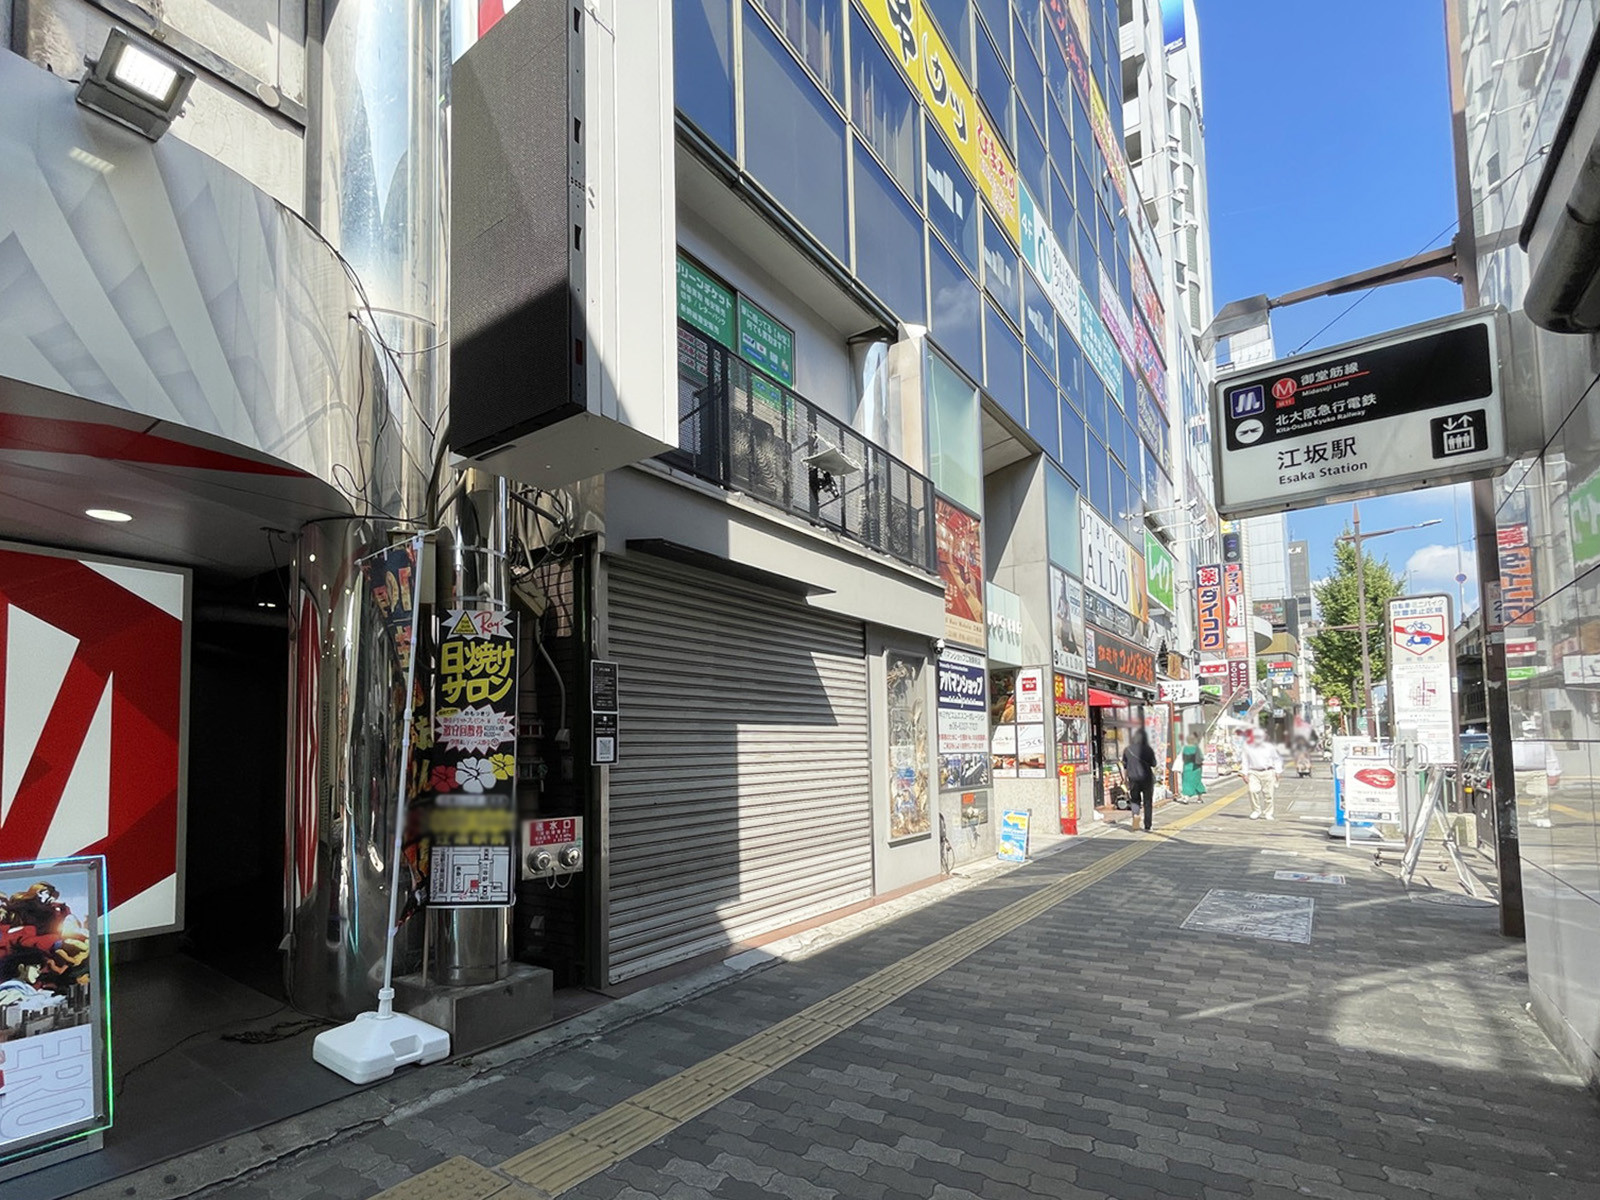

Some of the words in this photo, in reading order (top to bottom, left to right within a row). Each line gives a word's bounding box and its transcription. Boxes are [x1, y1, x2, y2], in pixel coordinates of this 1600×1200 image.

[1301, 362, 1359, 386] 御堂筋線
[1333, 380, 1350, 390] Line
[1275, 393, 1377, 426] 北大阪急行電鉄
[1276, 421, 1313, 435] Kita-Osaka
[1337, 409, 1367, 421] Railway
[1277, 436, 1357, 470] 江坂駅
[1279, 471, 1315, 485] Esaka
[1319, 462, 1368, 478] Station
[1200, 587, 1219, 648] ダイコク
[441, 640, 514, 677] 日焼け
[442, 673, 513, 703] サロン
